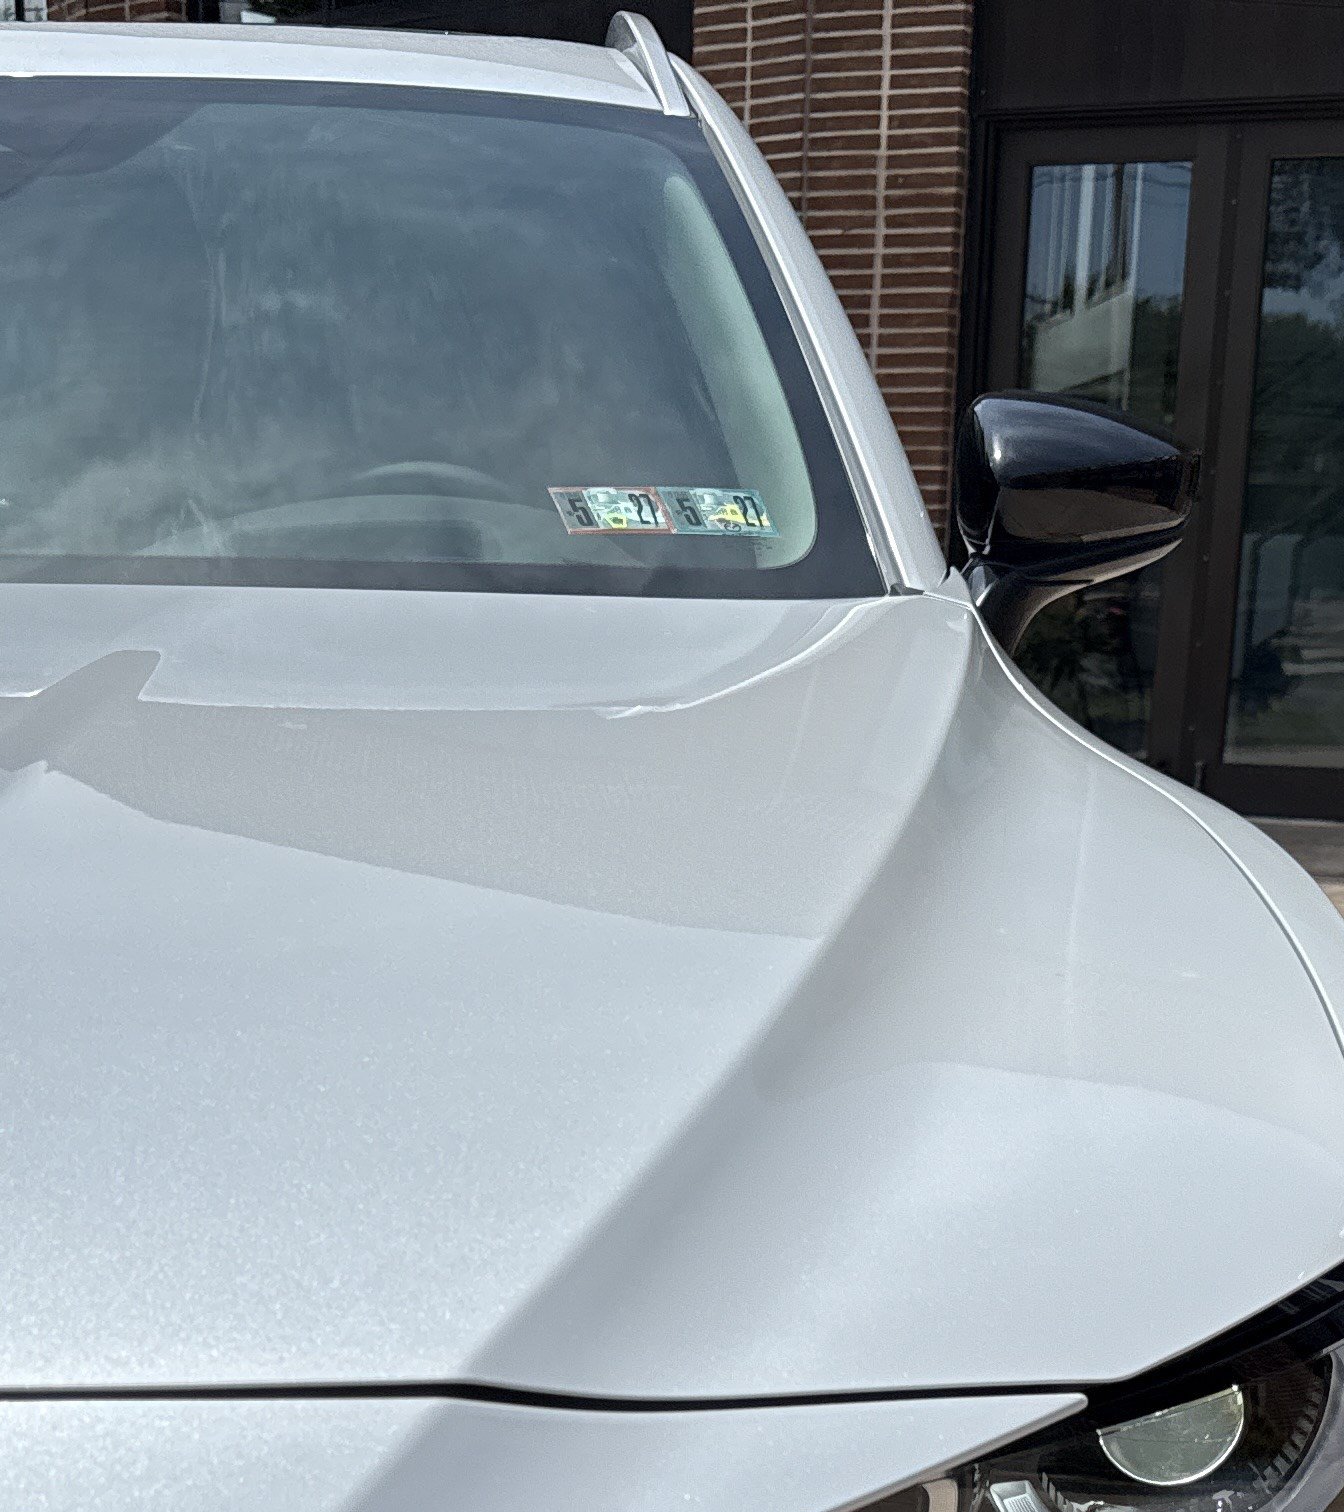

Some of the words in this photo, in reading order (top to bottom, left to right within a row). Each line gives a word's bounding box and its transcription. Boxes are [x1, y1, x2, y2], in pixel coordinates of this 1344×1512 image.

[567, 497, 595, 527] 5
[627, 493, 660, 528] 27
[675, 498, 703, 526] 5
[732, 496, 765, 529] 27
